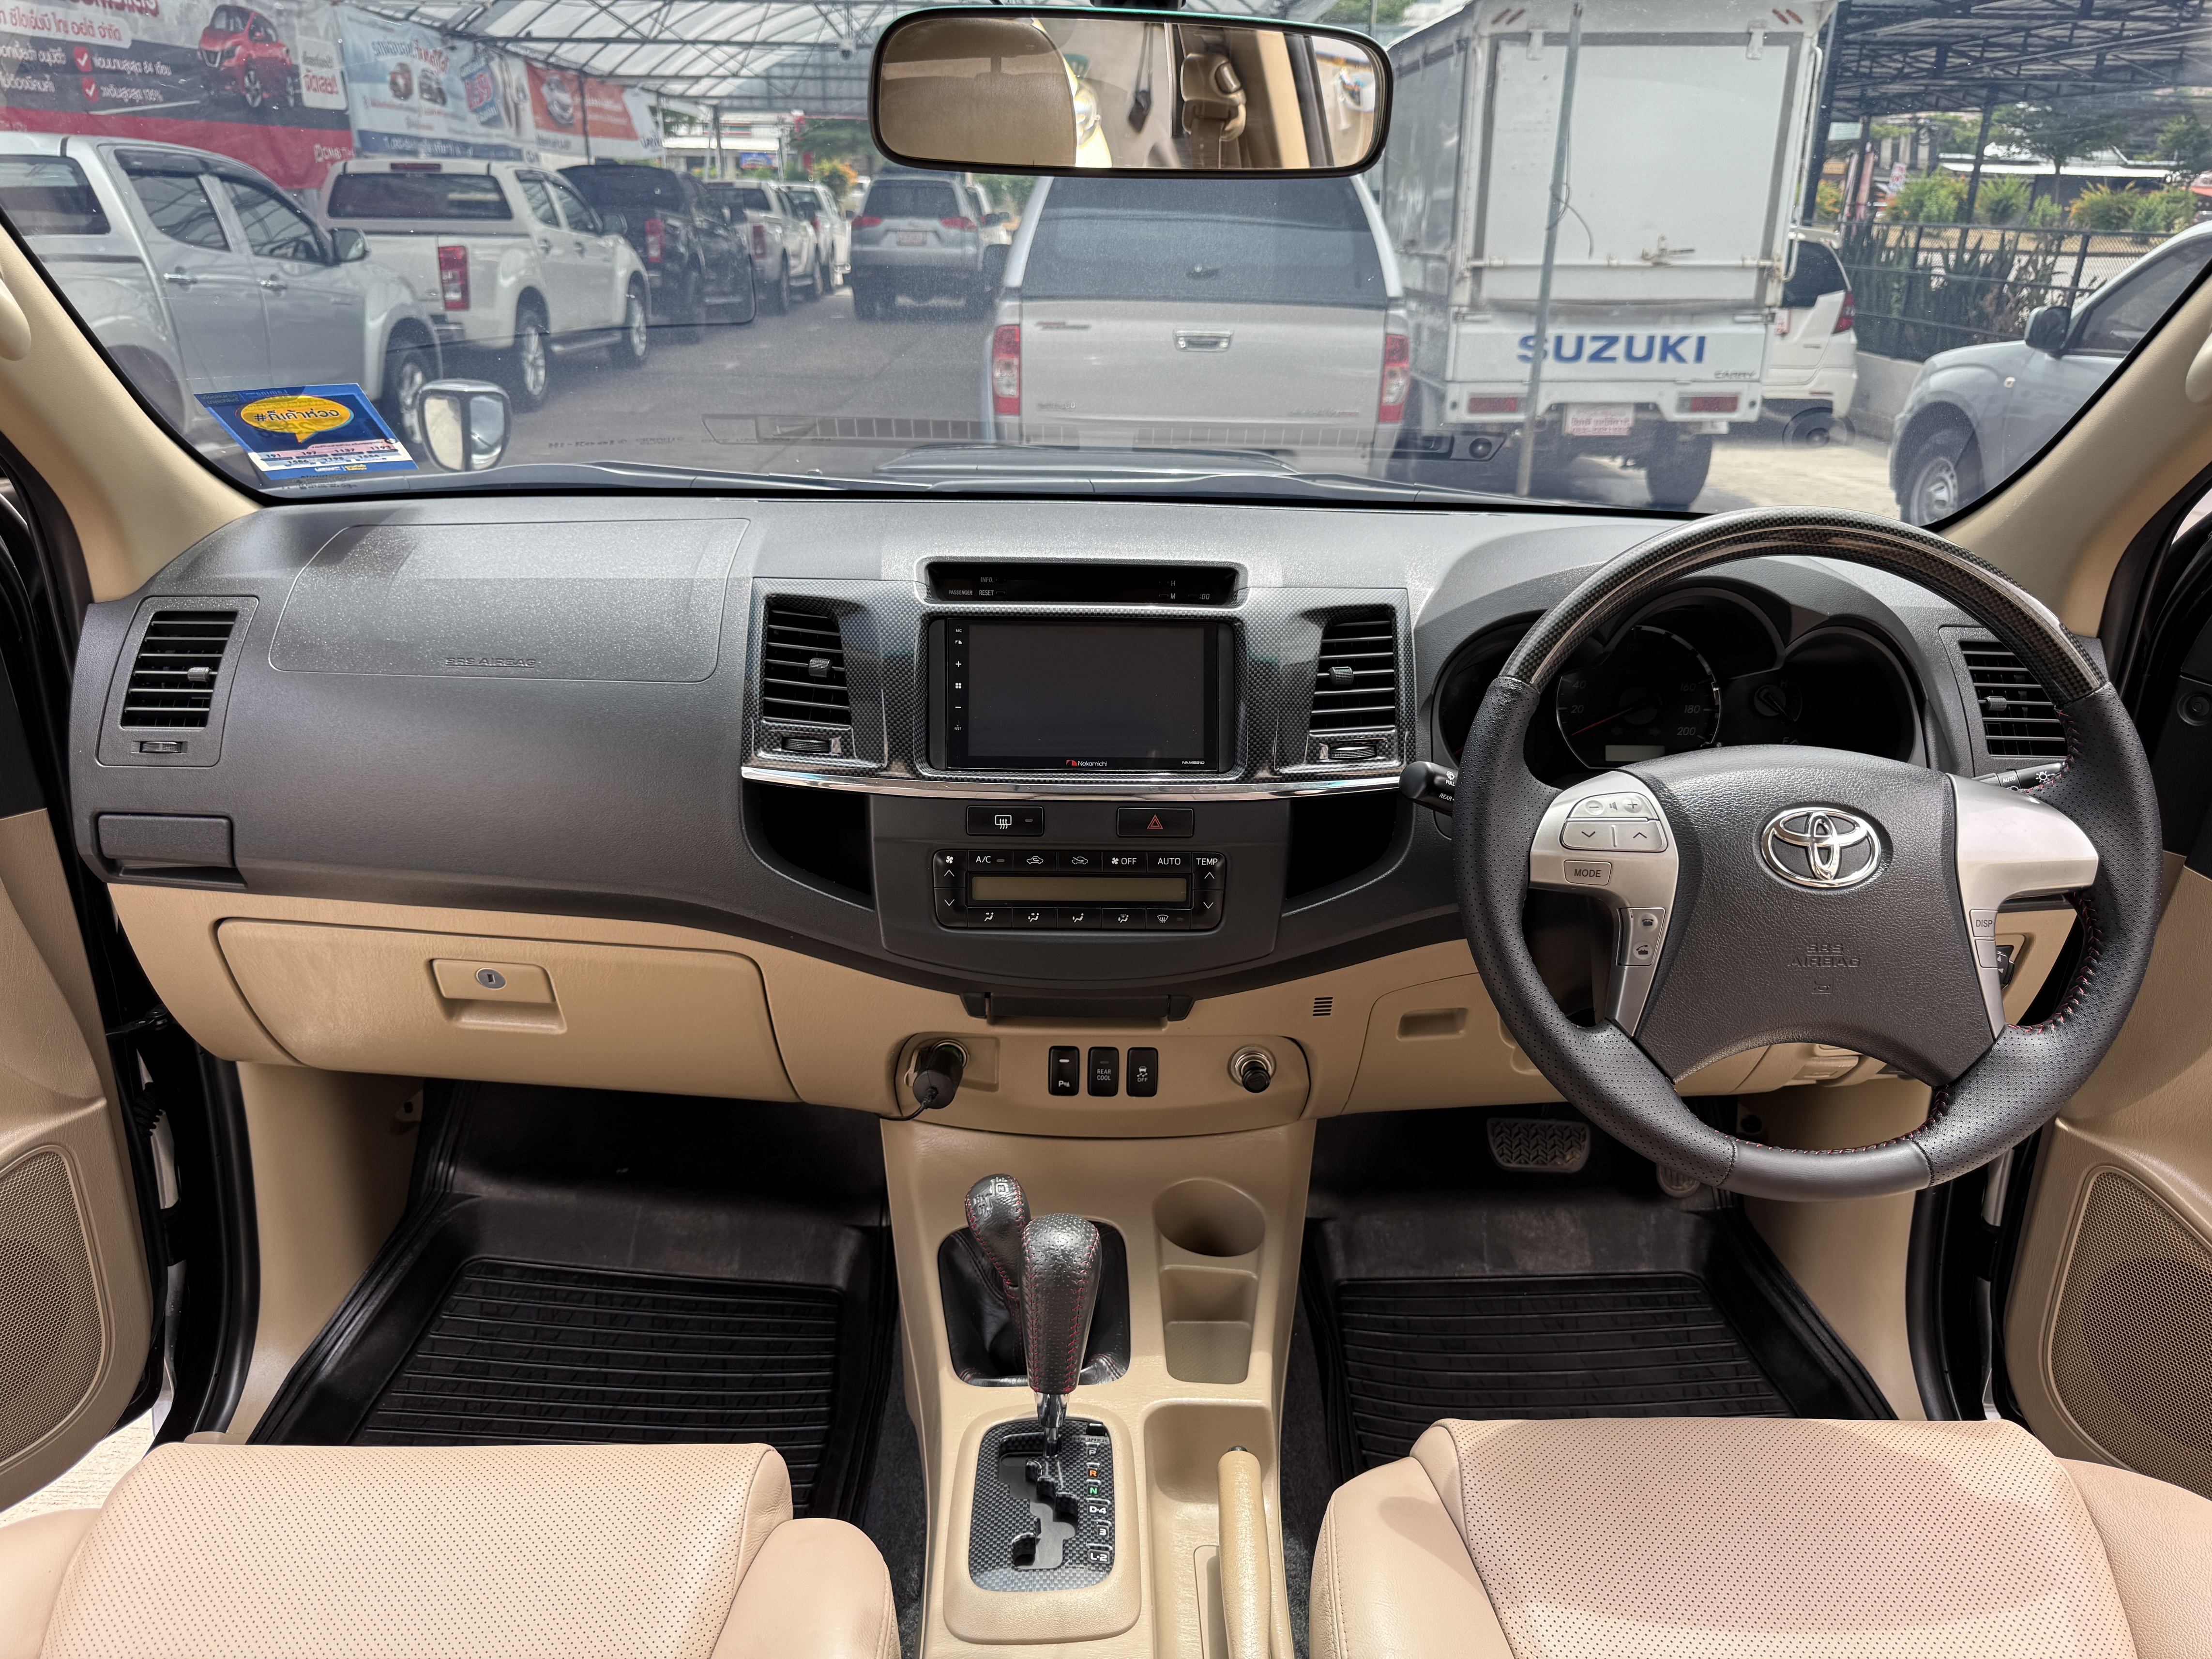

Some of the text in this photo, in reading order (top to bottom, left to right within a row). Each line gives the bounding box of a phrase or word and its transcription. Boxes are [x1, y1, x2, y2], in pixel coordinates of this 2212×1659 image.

[1517, 335, 1706, 364] SUZUKI
[1573, 680, 1586, 689] 40
[1680, 682, 1697, 692] 160
[1570, 704, 1584, 714] 20
[1684, 704, 1701, 714] 180
[1676, 727, 1696, 736] 200
[975, 855, 991, 864] A/C
[1121, 857, 1137, 865] OFF
[1157, 857, 1181, 866] AUTO
[1196, 857, 1218, 866] TEMP
[1574, 868, 1602, 878] MODE
[1976, 919, 1993, 928] DISP
[1788, 957, 1861, 967] AIRBAG
